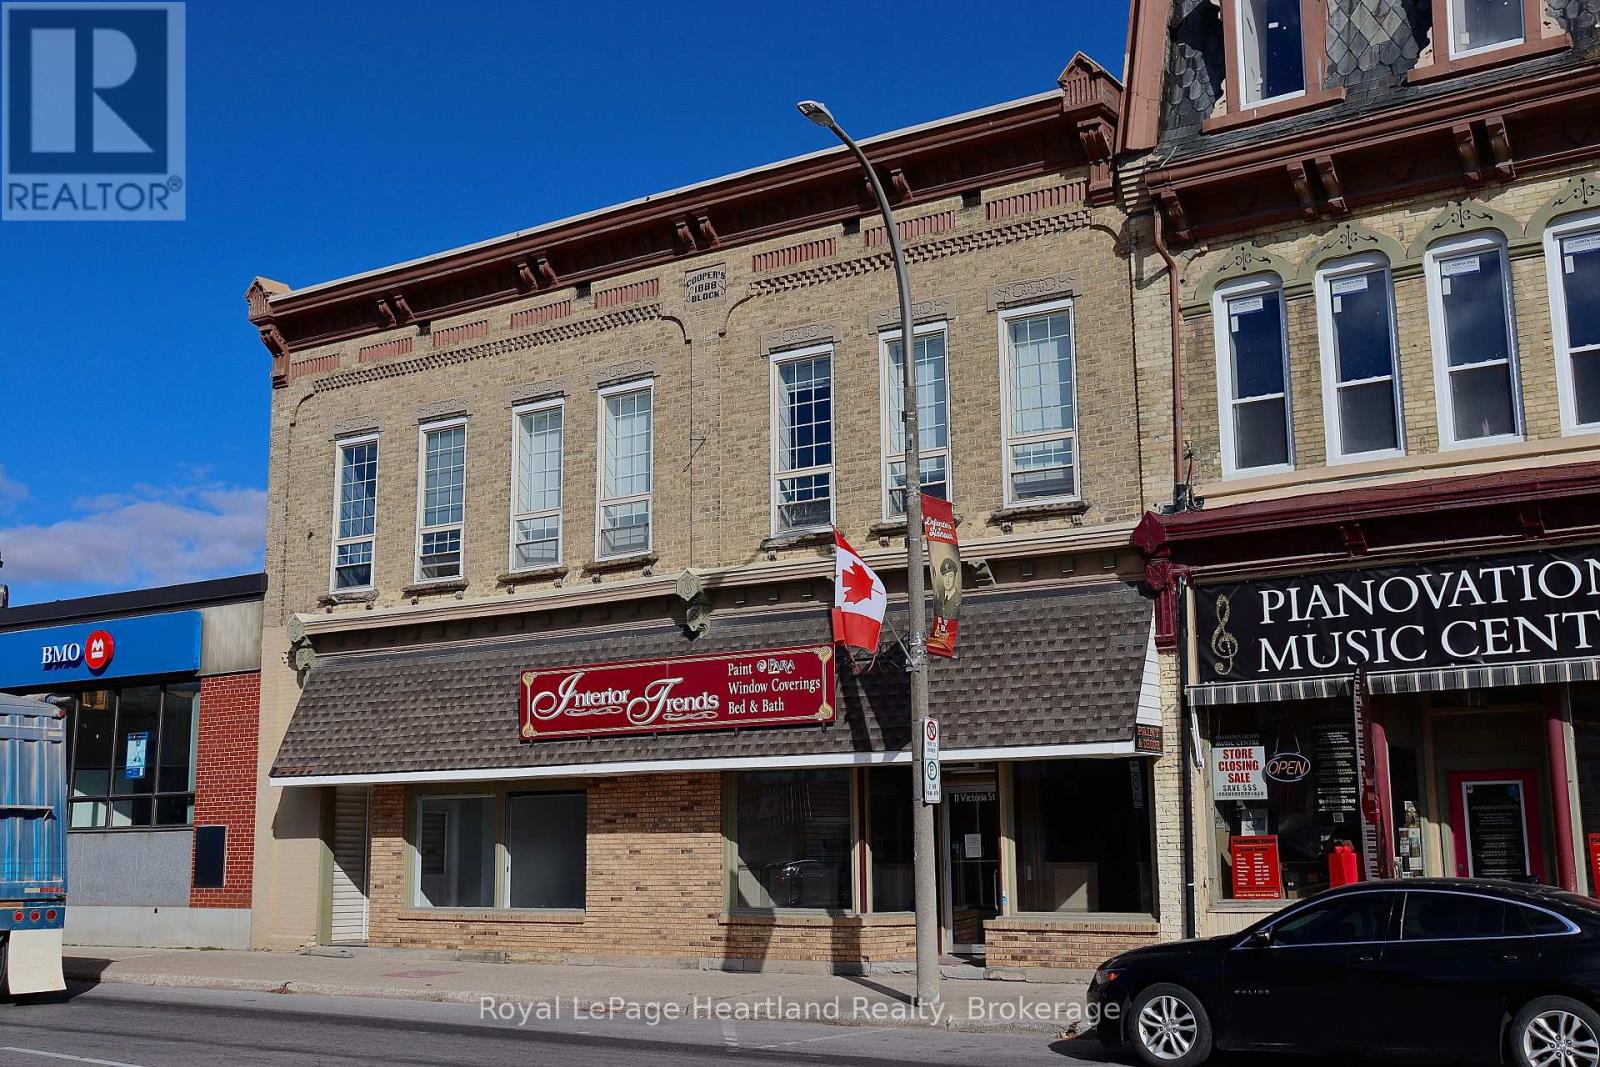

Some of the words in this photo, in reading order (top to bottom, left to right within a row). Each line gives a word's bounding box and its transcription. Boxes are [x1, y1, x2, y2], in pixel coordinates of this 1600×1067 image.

[686, 271, 725, 287] COOPER'S
[694, 281, 717, 293] 1888
[691, 290, 720, 302] BLOCK
[1257, 625, 1427, 672] MUSIC
[1441, 609, 1600, 658] CENT
[41, 643, 80, 664] BMO
[728, 663, 753, 676] Paint
[767, 658, 796, 674] PARA
[728, 679, 768, 695] Window
[771, 676, 821, 693] Coverings
[532, 671, 631, 720] Interior
[626, 677, 720, 726] Trends
[728, 699, 746, 714] Bed
[750, 700, 758, 713] &
[762, 697, 785, 713] Bath
[1223, 748, 1254, 760] STORE
[1218, 760, 1260, 771] CLOSING
[1268, 760, 1307, 775] OPEN
[1228, 772, 1251, 783] SALE
[1223, 784, 1241, 792] SAVE
[960, 793, 987, 802] Victoria
[988, 792, 996, 801] St
